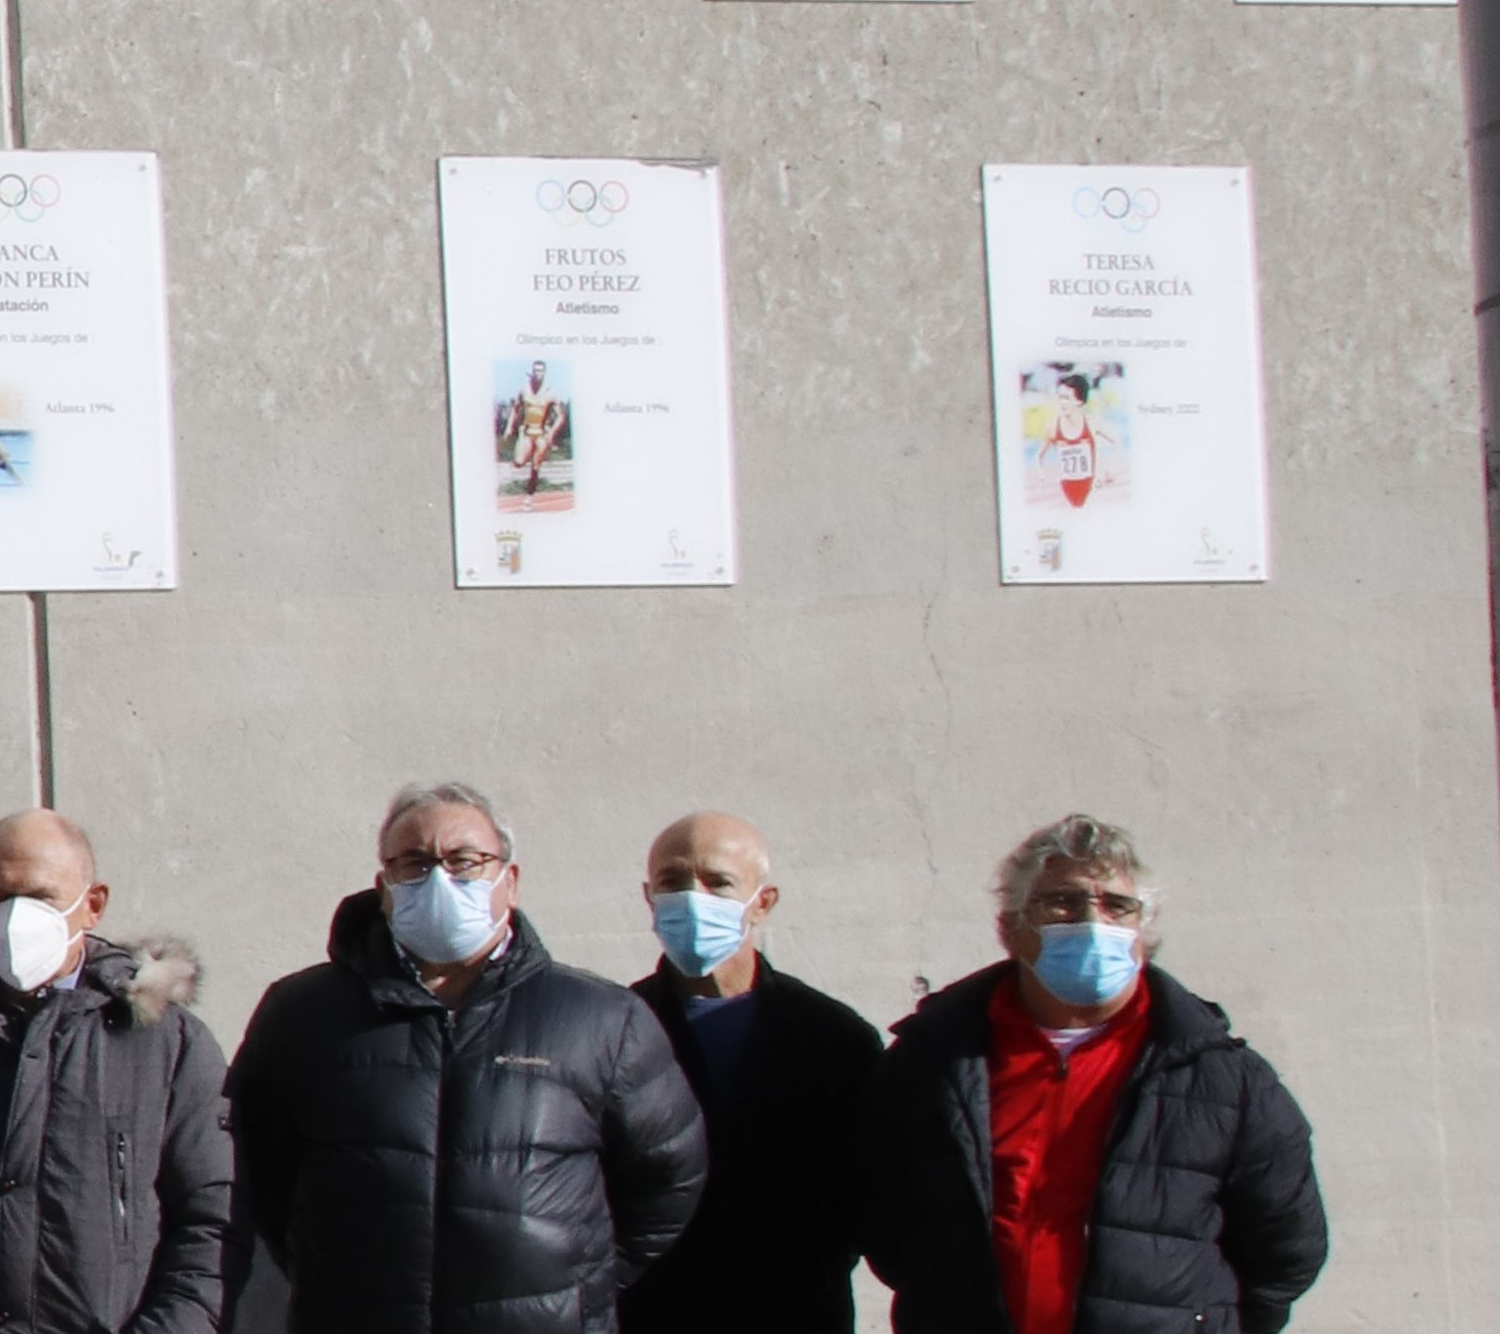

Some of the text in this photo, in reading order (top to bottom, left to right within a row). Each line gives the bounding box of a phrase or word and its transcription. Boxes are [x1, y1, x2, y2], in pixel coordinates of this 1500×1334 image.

[545, 249, 626, 266] FRUTOS
[1084, 254, 1155, 270] TERESA
[26, 267, 89, 288] PERÍN
[534, 270, 640, 291] FEO PÉREZ
[1049, 276, 1192, 296] RECIO GARCÍA
[556, 302, 619, 315] Atletismo
